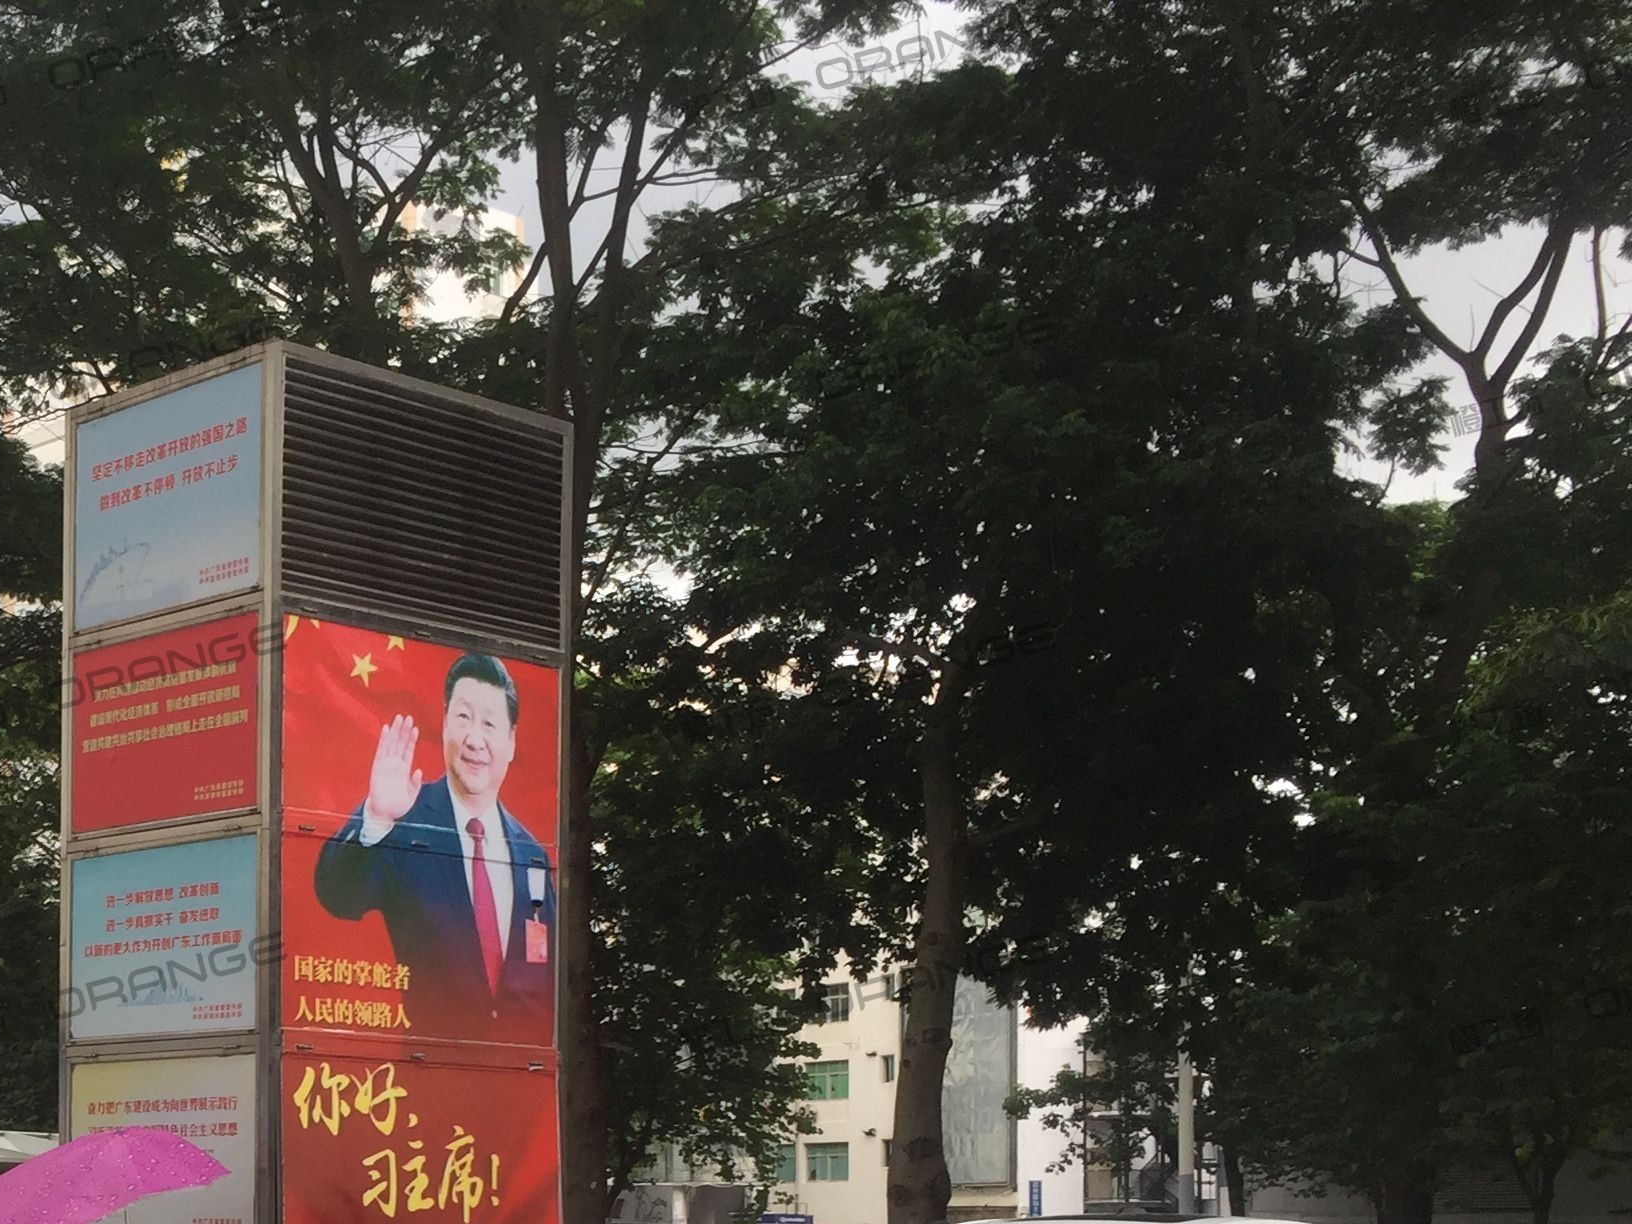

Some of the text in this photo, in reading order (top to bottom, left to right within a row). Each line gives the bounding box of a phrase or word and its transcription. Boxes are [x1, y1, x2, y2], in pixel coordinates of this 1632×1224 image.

[91, 416, 248, 482] 坚定不移走改革开放的强国之路
[181, 454, 239, 487] 开放不止步
[105, 882, 221, 908] 进一步解放思想 改革创新
[105, 907, 220, 932] 进一步真抓实干 奋发进取
[293, 955, 411, 991] 国家的掌舵者
[293, 995, 412, 1029] 人民的领路人
